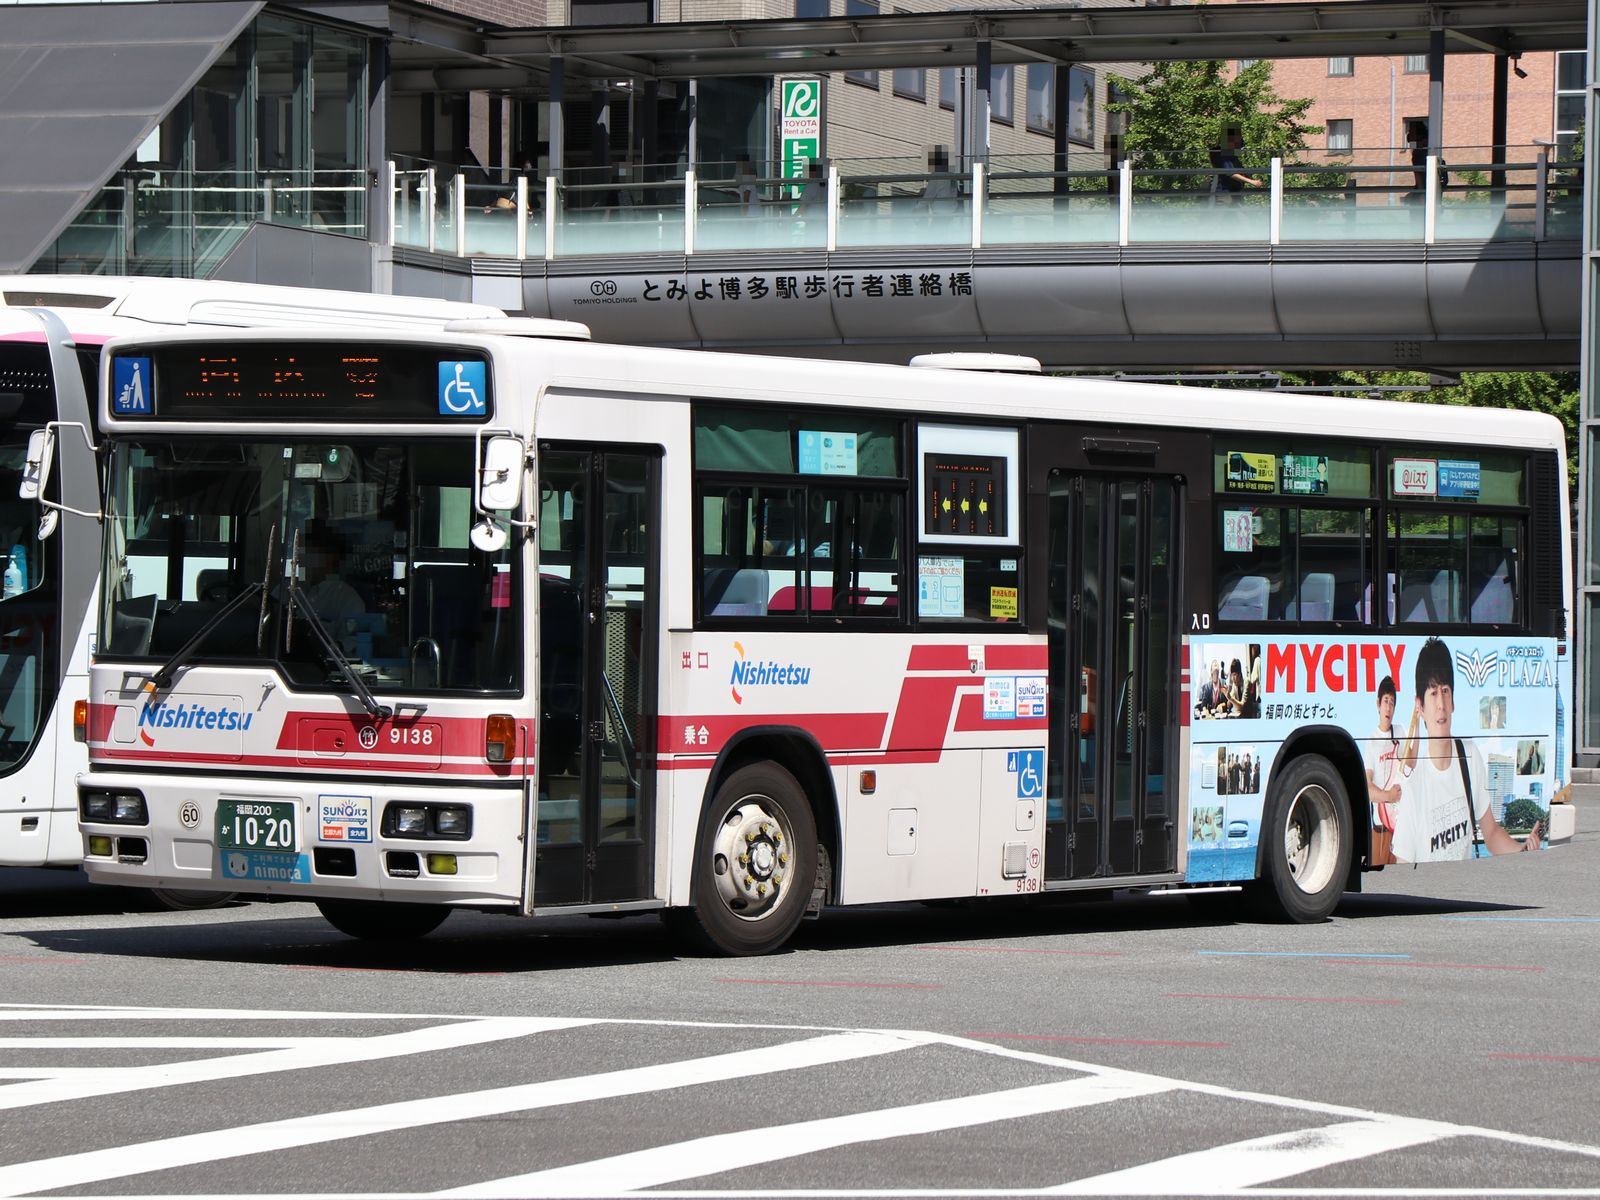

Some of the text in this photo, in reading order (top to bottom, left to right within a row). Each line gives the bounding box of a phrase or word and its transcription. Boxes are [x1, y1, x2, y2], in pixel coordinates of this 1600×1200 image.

[643, 272, 973, 301] とみよ博多駅歩行者連絡橋
[1191, 613, 1210, 630] 入口
[682, 652, 709, 669] 出口
[1265, 643, 1406, 693] MYCITY
[730, 660, 811, 685] Nishitetsu
[1498, 659, 1554, 687] PLAZA
[138, 702, 253, 731] Nishitetsu
[1265, 703, 1338, 720] 福岡の街とずっと。
[390, 728, 433, 745] 9138
[684, 725, 710, 745] 乗合
[182, 808, 198, 823] 60
[221, 816, 292, 848] か 10-20
[1430, 820, 1468, 853] MYCITY
[254, 863, 302, 880] nimoca
[1016, 878, 1037, 893] 9138
